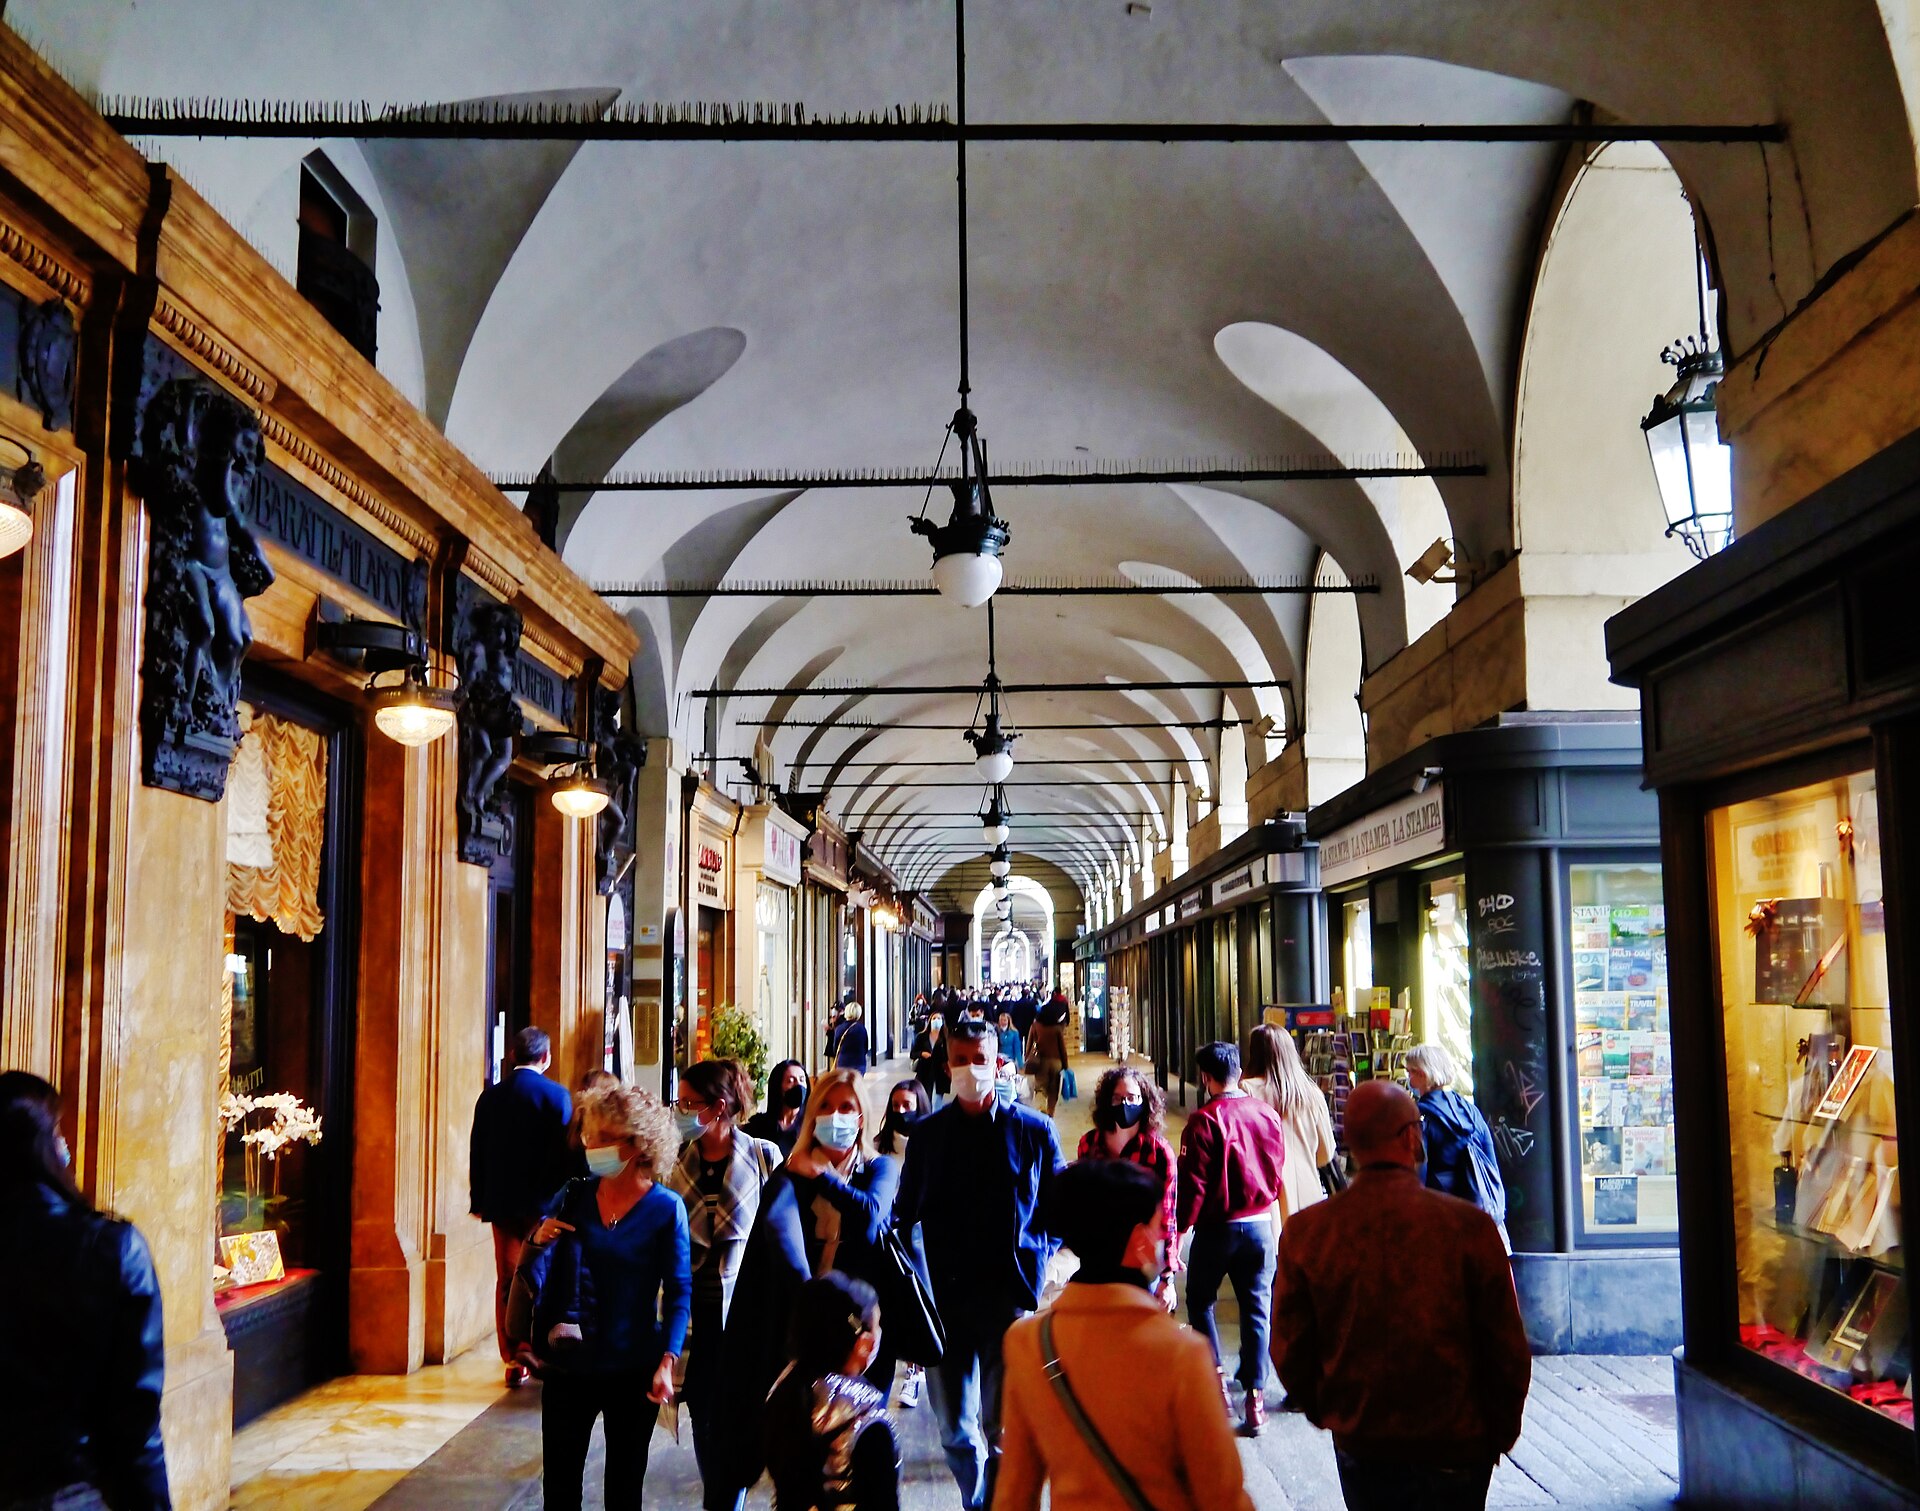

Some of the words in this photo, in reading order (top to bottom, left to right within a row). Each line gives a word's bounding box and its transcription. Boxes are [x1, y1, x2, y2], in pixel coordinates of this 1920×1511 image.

[256, 471, 336, 572] BARATTI
[338, 529, 400, 611] MILANO
[1320, 848, 1328, 869] LA
[1328, 839, 1351, 867] STAMPA
[1351, 834, 1361, 859] LA
[1361, 821, 1391, 856] STAMPA
[1392, 816, 1405, 842] LA
[1406, 800, 1442, 837] STAMPA
[230, 1066, 264, 1094] ARATTI
